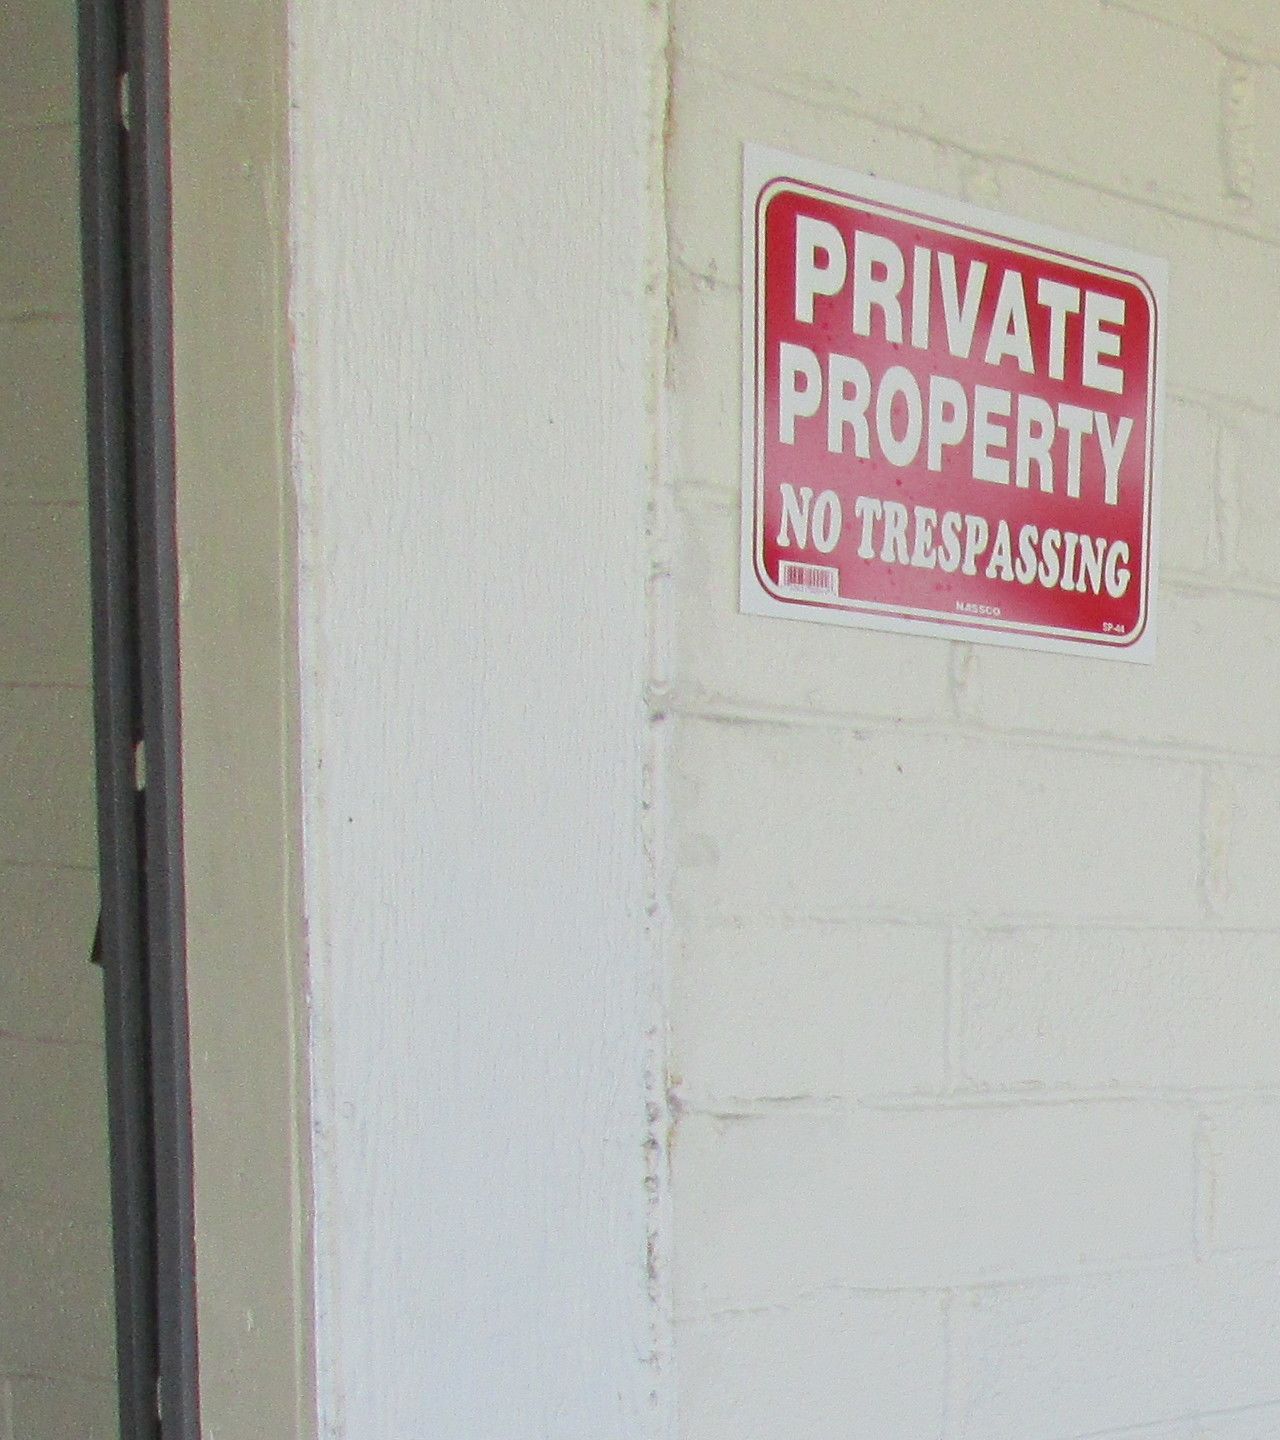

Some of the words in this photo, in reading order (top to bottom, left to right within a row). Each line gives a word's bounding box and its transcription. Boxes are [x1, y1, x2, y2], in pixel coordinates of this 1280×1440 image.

[795, 213, 1126, 395] PRIVATE
[778, 341, 1134, 506] PROPERTY
[776, 482, 844, 554] NO
[855, 495, 1132, 599] TRESPASSING
